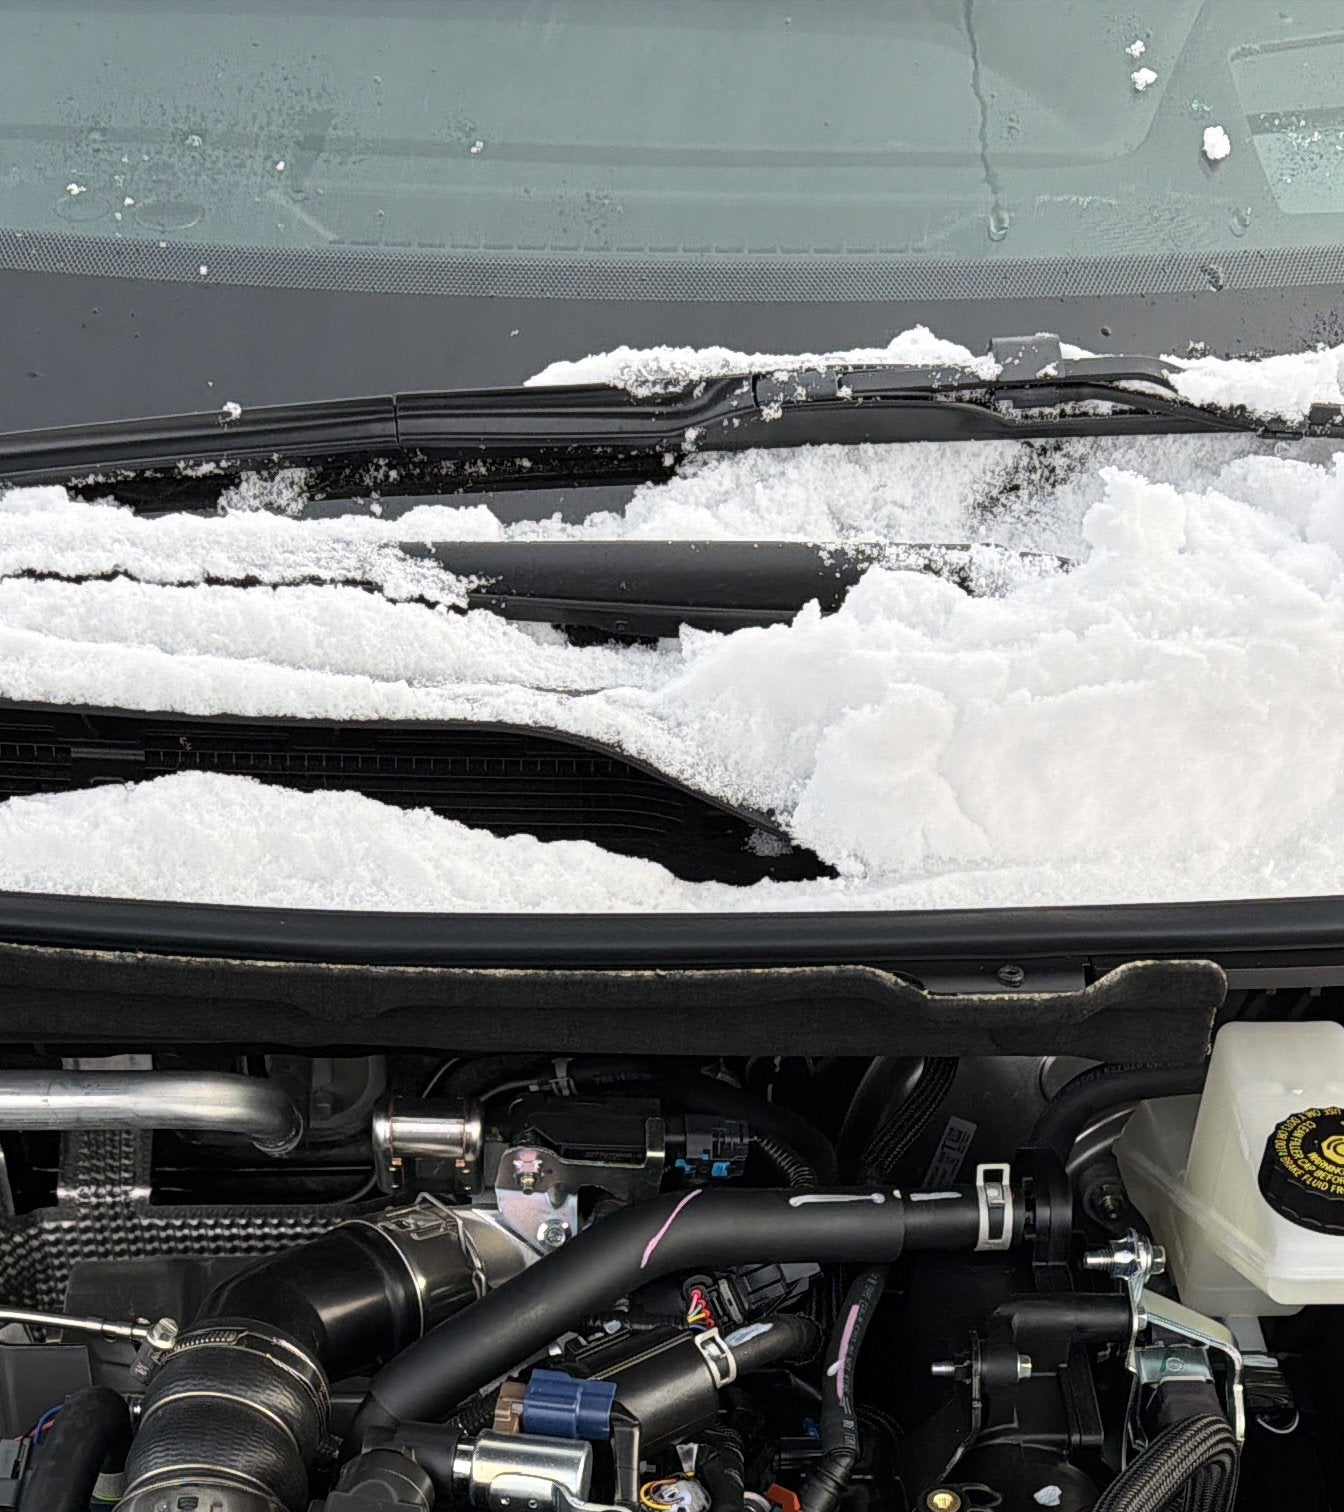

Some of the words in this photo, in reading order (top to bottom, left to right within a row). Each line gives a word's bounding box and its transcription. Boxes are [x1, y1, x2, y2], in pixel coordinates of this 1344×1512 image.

[1280, 1155, 1305, 1177] BRAKE
[1301, 1174, 1329, 1191] FLUID
[1297, 1158, 1316, 1173] CAP
